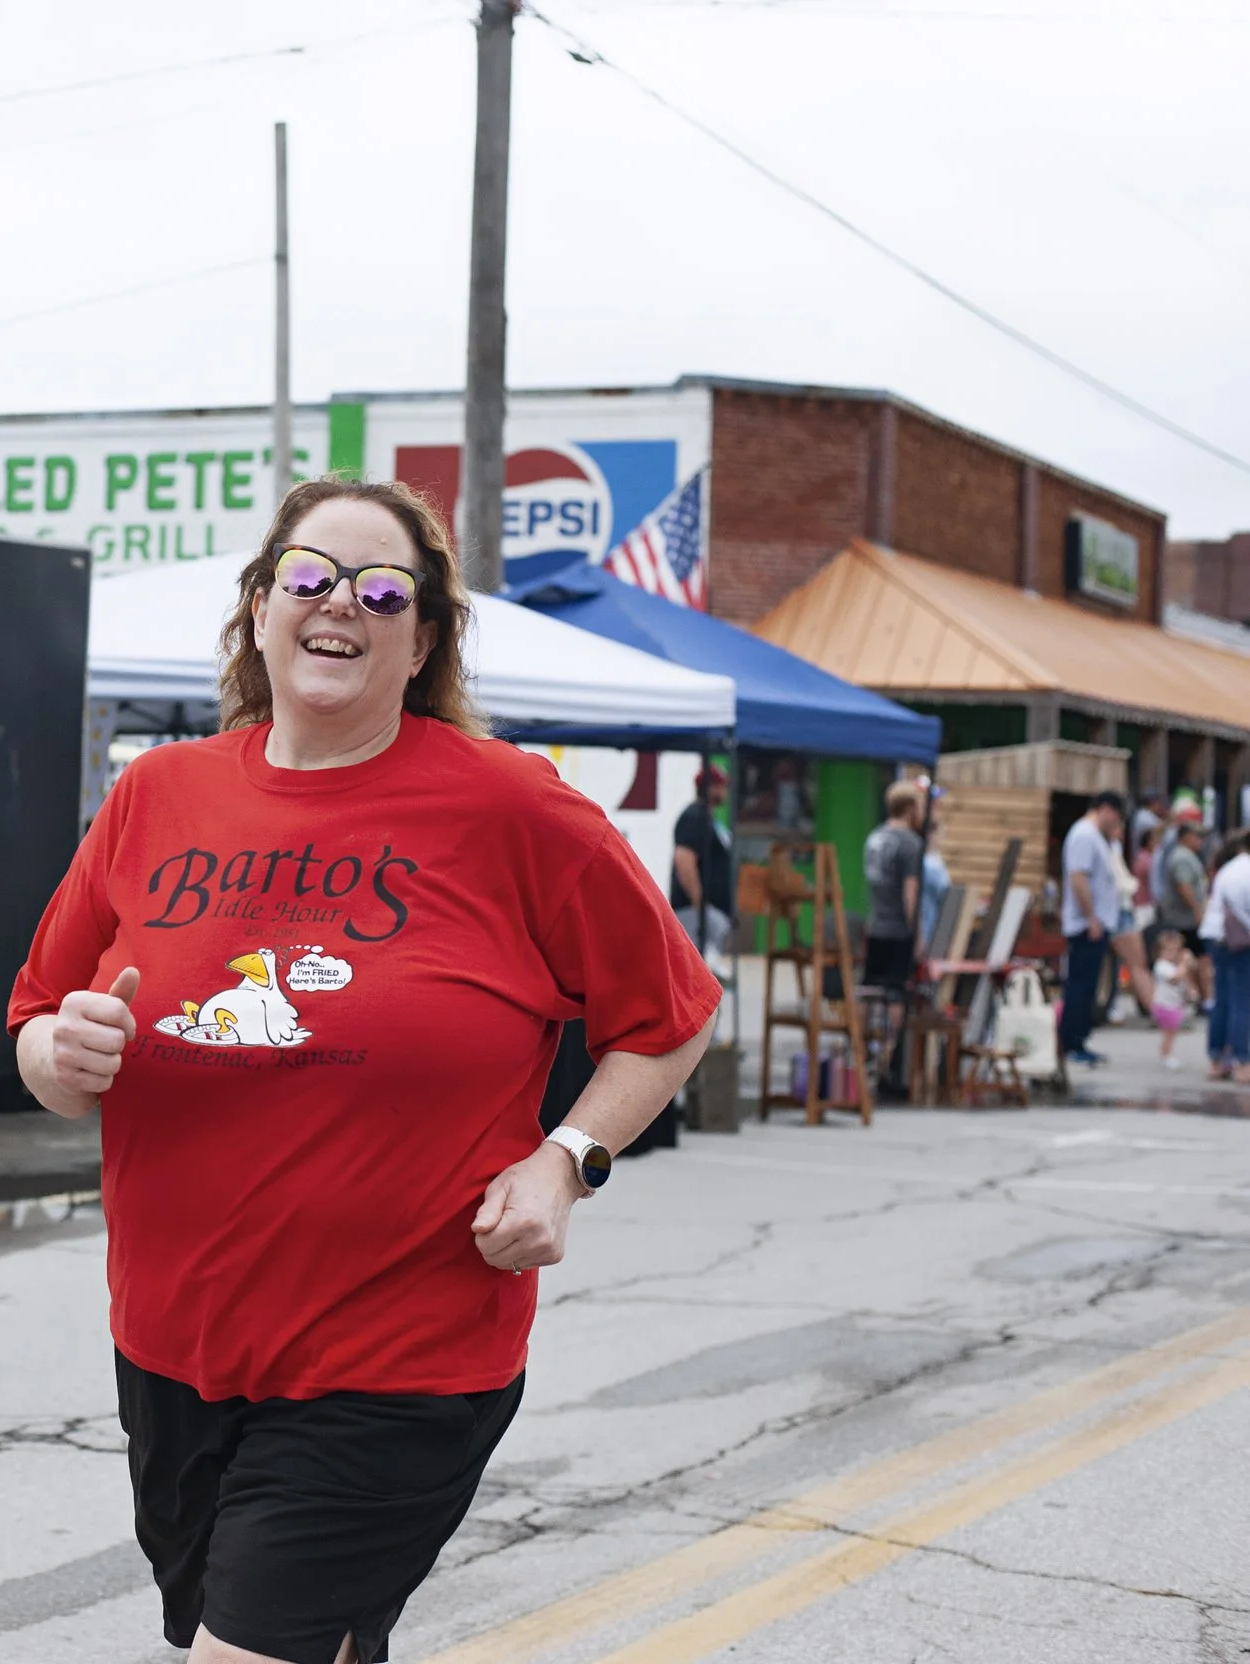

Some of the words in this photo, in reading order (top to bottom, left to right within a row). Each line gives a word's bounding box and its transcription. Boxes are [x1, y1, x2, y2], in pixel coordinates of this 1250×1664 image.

[502, 501, 599, 537] EPSI
[213, 897, 263, 920] Idle
[271, 901, 343, 923] Hour
[289, 977, 316, 985] Here's
[318, 977, 346, 985] Barto!
[312, 969, 340, 977] FRIED
[271, 1048, 368, 1070] Kansas
